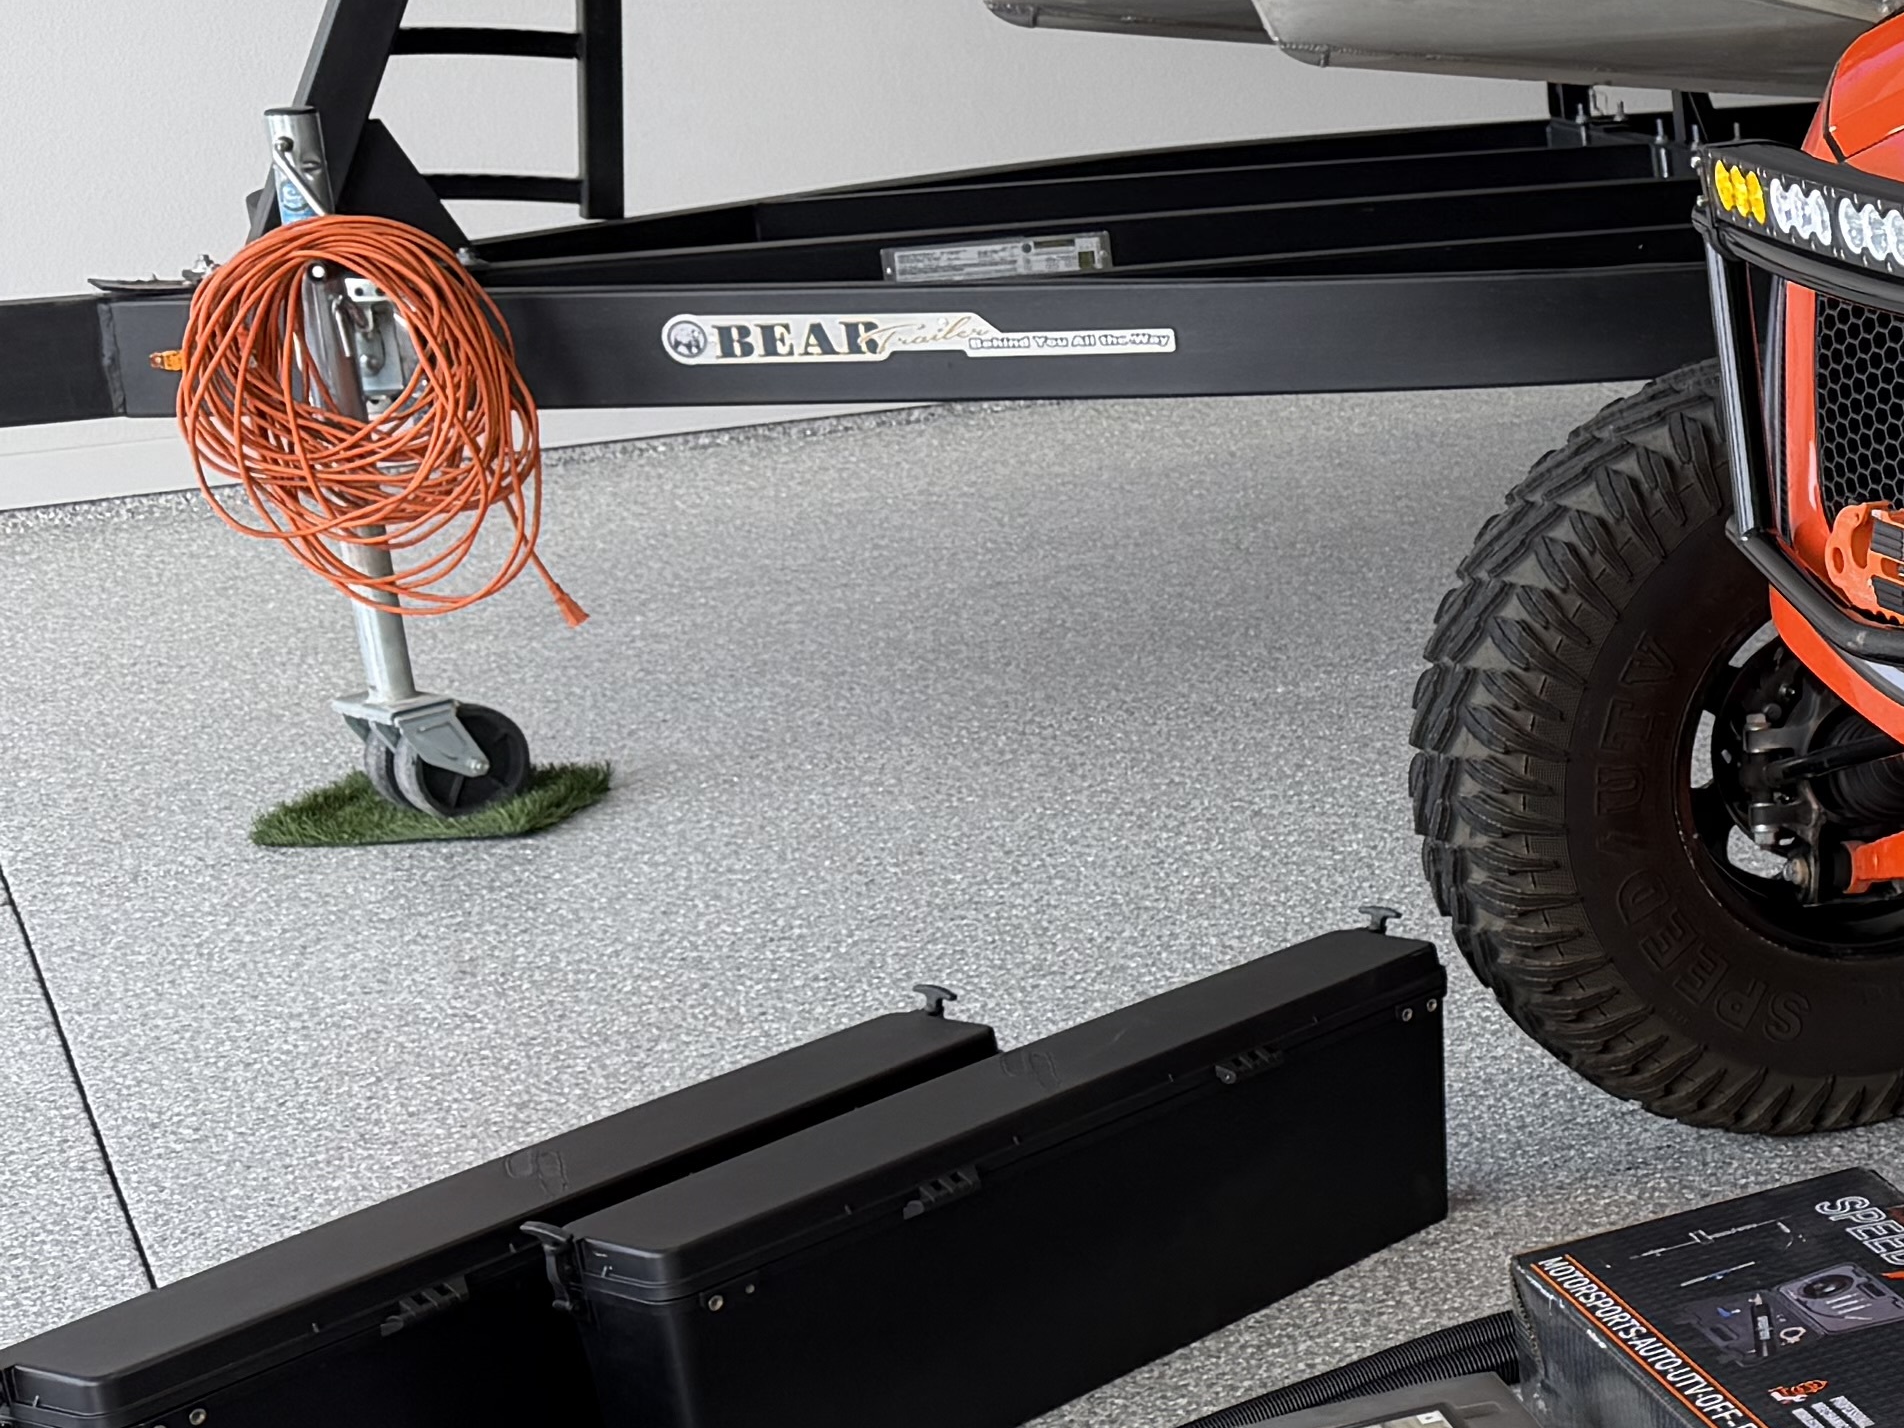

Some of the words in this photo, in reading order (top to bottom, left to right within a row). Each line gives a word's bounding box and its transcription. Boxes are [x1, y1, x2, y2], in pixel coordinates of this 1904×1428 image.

[711, 321, 880, 360] BEAR
[968, 336, 1030, 350] Behind
[1033, 335, 1069, 349] You
[1072, 334, 1096, 348] All
